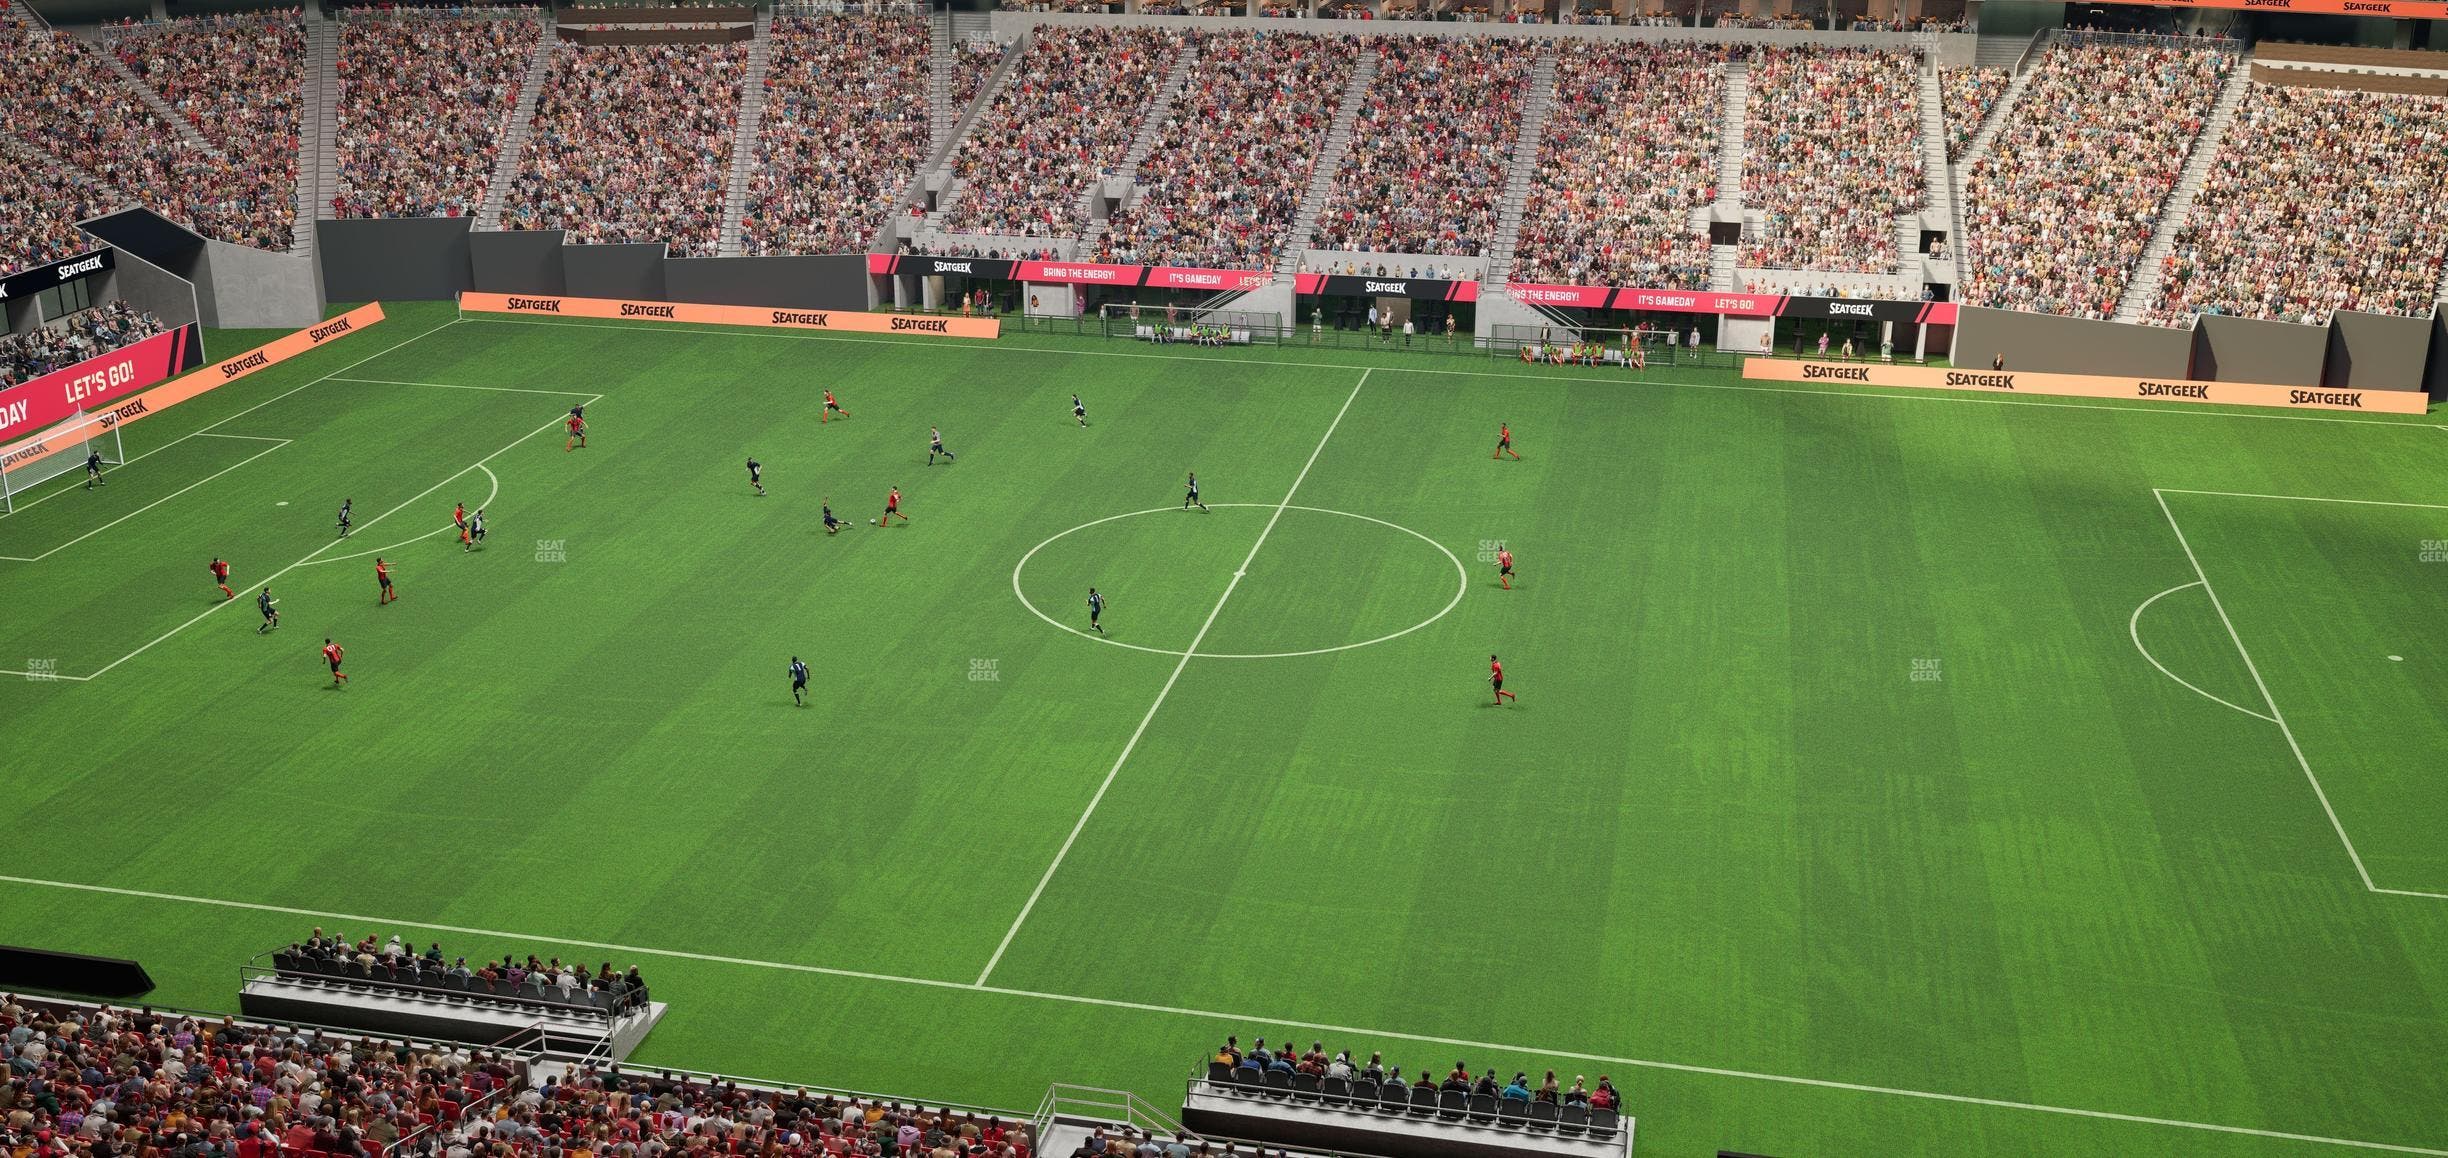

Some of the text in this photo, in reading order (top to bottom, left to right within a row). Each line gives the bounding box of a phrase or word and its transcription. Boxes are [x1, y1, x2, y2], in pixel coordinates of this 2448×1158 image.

[2343, 2, 2391, 12] SEATGEEK
[58, 255, 103, 280] SEATGEEK
[933, 261, 972, 274] SEATGEEK
[1043, 267, 1115, 280] BRING THE ENERGY!
[1169, 273, 1184, 283] IT'S
[1185, 274, 1222, 285] GAMEDAY
[1365, 281, 1406, 294] SEATGEEK
[1528, 290, 1541, 300] THE
[1545, 291, 1579, 302] ENERGY!
[1638, 295, 1754, 310] IT'S GAMEDAY LET'S GO!
[507, 297, 560, 312] SEATGEEK
[620, 303, 675, 318] SEATGEEK
[1829, 303, 1874, 316] SEATGEEK
[772, 311, 828, 326] SEATGEEK
[891, 317, 948, 332] SEATGEEK
[309, 317, 352, 343] SEATGEEK
[221, 350, 269, 378] SEATGEEK
[1802, 364, 1870, 381] SEATGEEK
[64, 370, 107, 404] LET'S
[108, 360, 135, 387] GO!
[1946, 372, 2014, 389] SEATGEEK
[2138, 382, 2209, 399] SEATGEEK
[2289, 390, 2362, 407] SEATGEEK
[1, 438, 49, 469] EATGEEK
